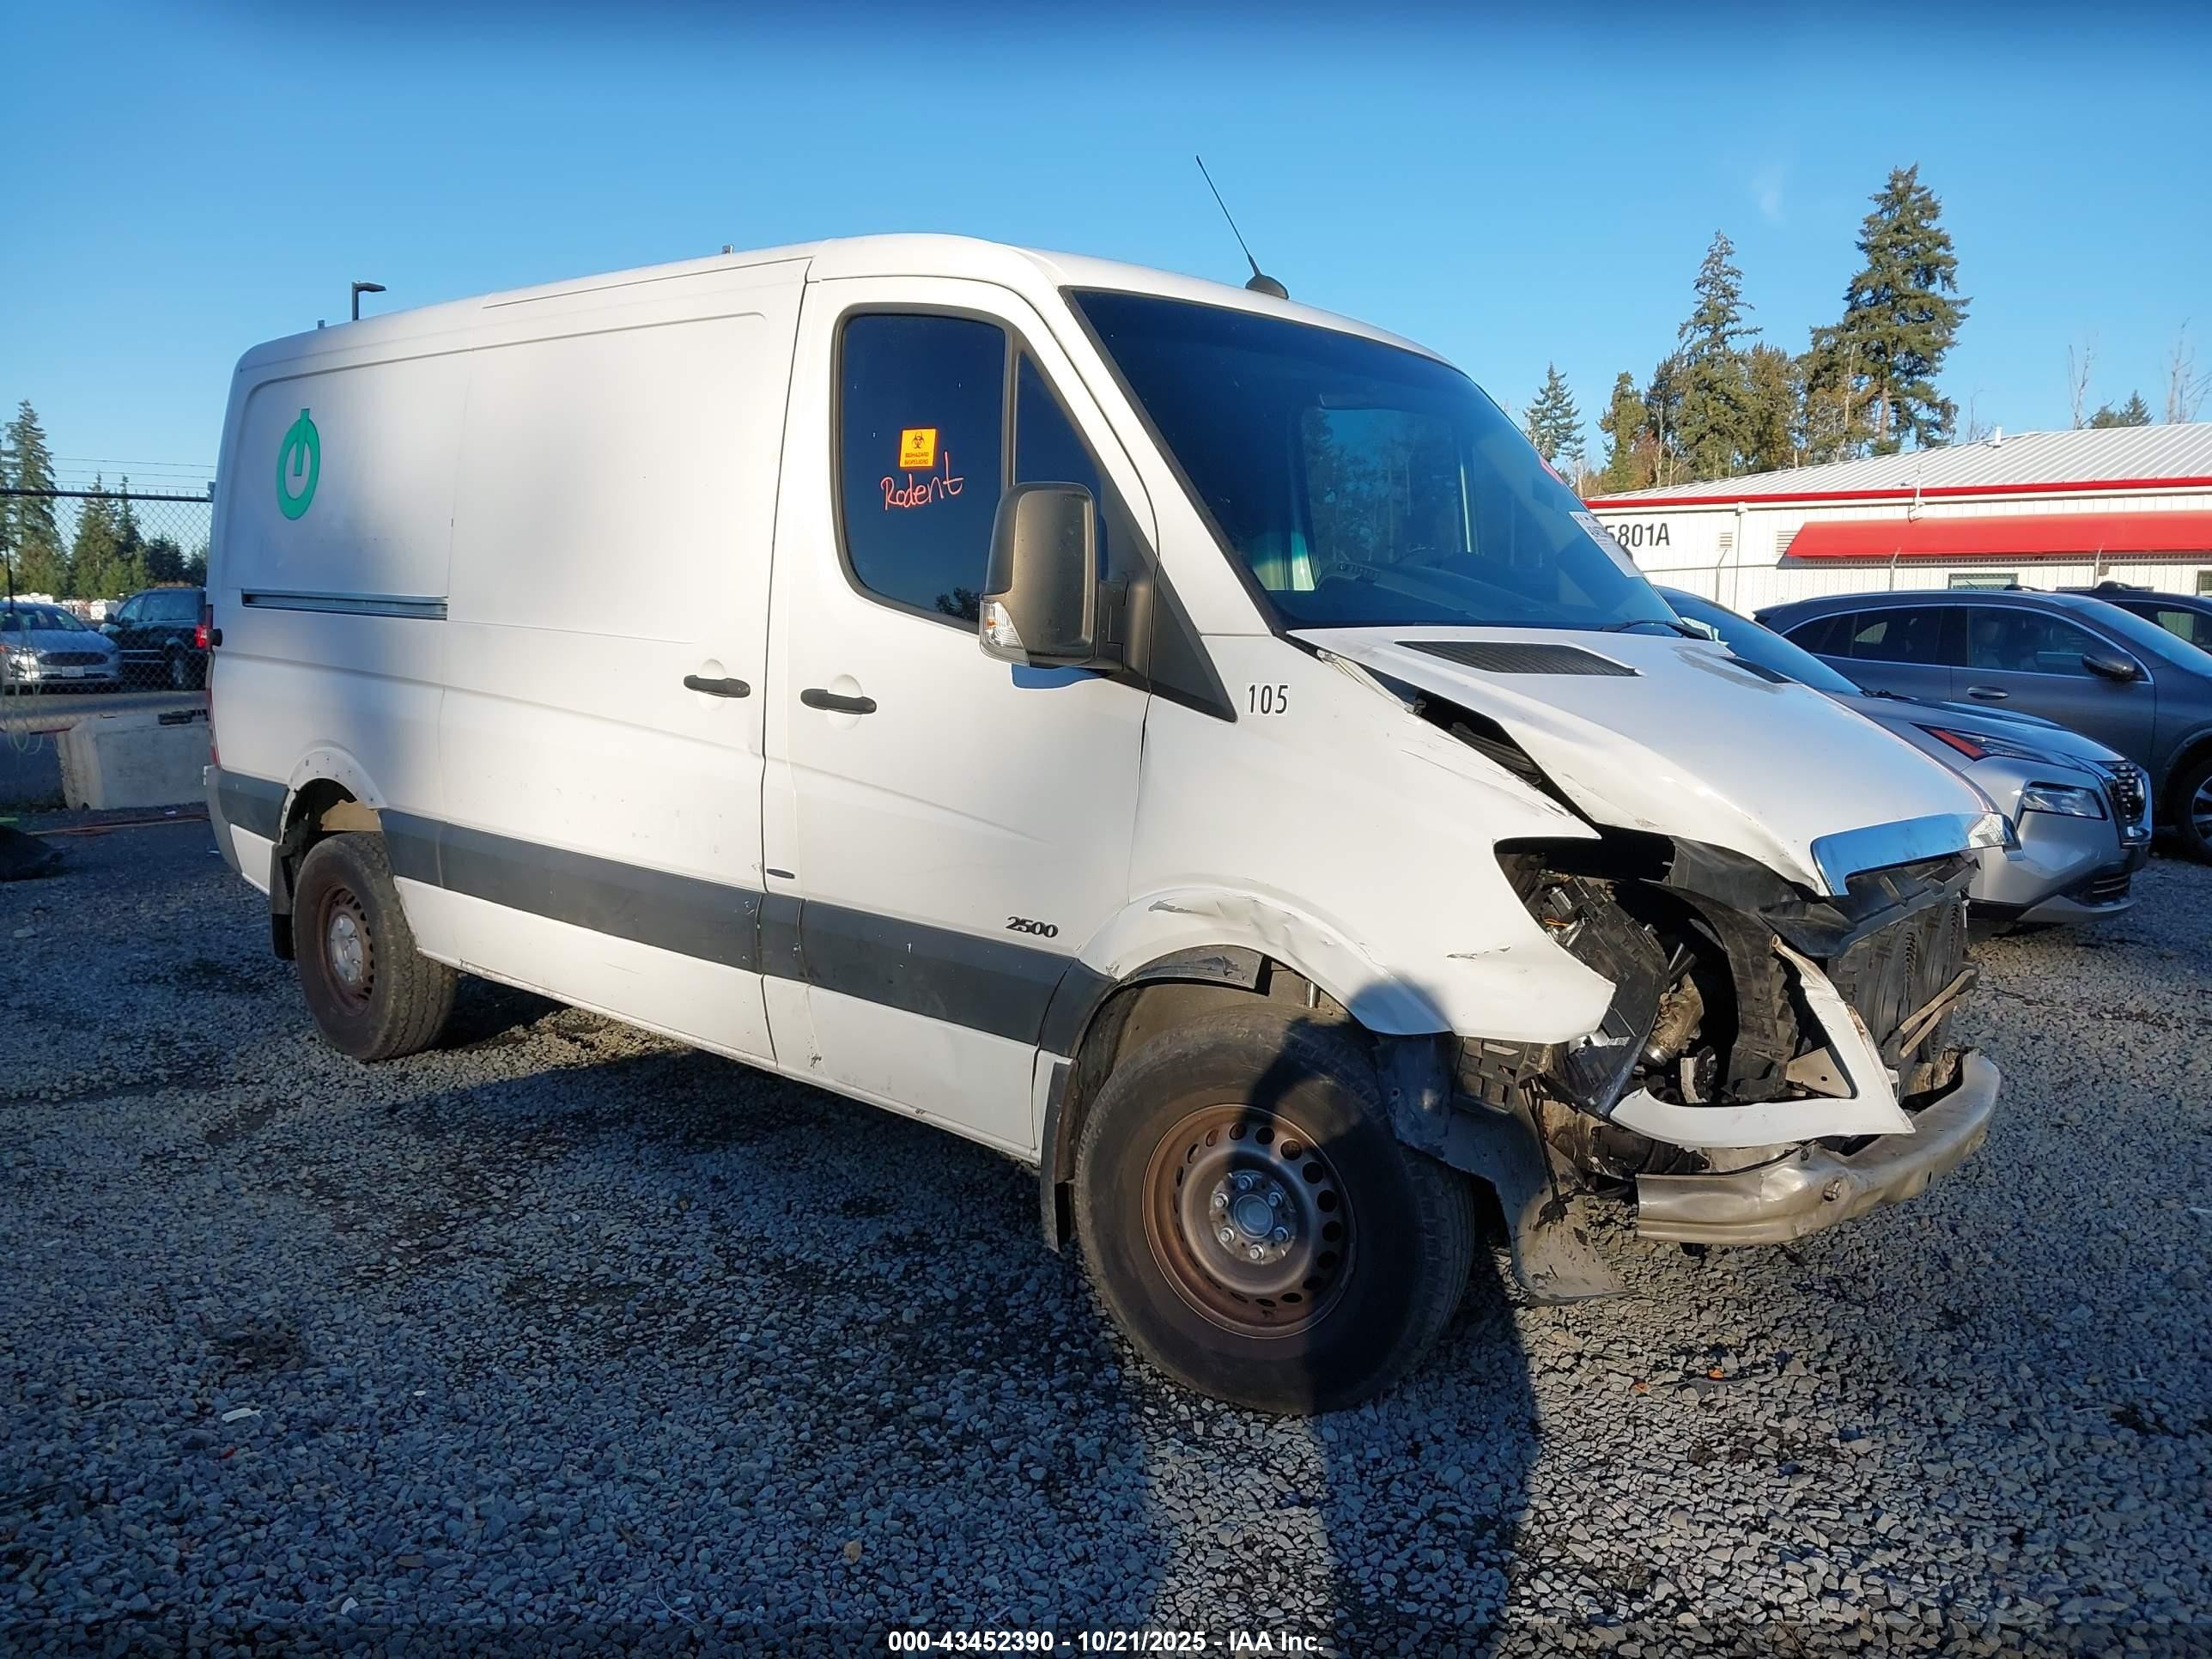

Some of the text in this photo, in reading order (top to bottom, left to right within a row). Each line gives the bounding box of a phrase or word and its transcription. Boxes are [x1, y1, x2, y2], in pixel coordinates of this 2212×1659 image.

[880, 452, 964, 511] Rodent
[1249, 684, 1289, 714] 105
[1006, 915, 1059, 938] 2500
